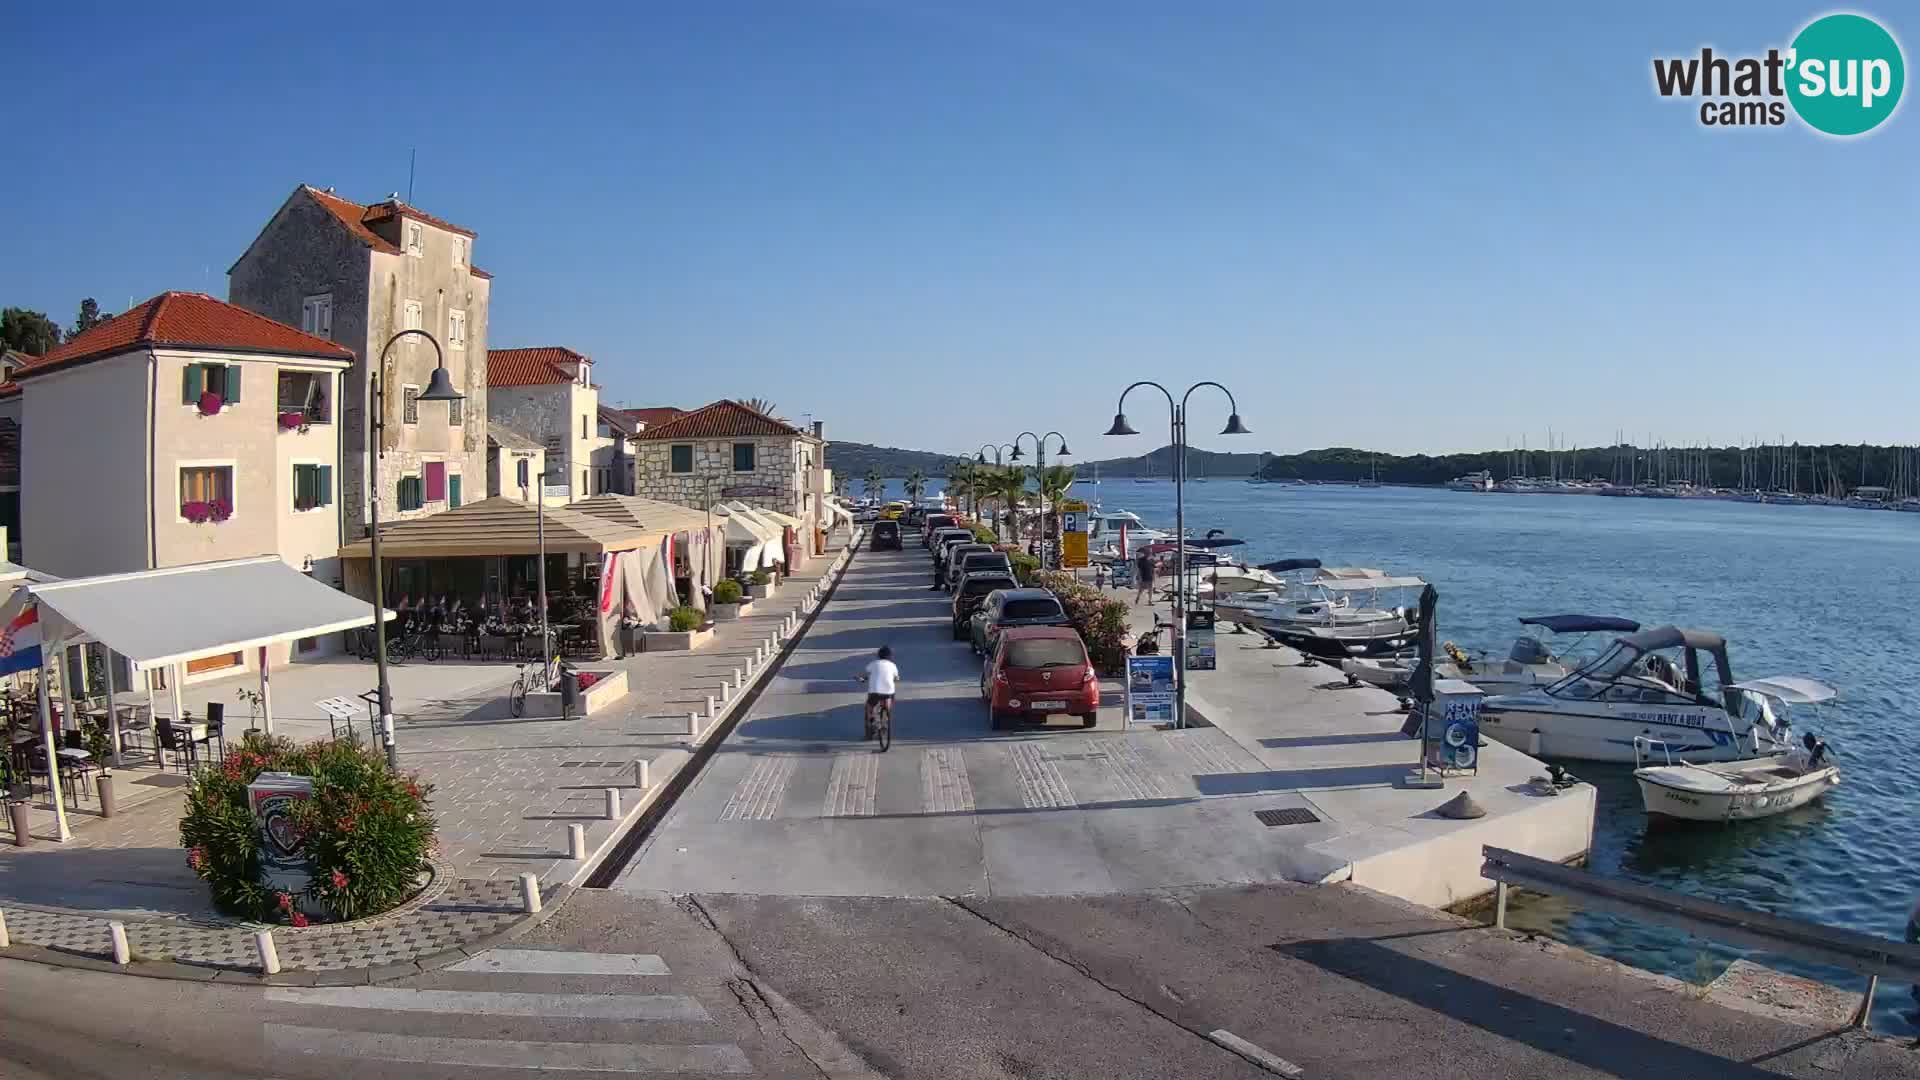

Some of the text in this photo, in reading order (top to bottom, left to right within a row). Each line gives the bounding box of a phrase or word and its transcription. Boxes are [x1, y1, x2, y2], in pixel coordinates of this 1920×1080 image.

[1065, 514, 1075, 530] P
[1447, 703, 1480, 712] RENT
[1657, 713, 1678, 725] RENT
